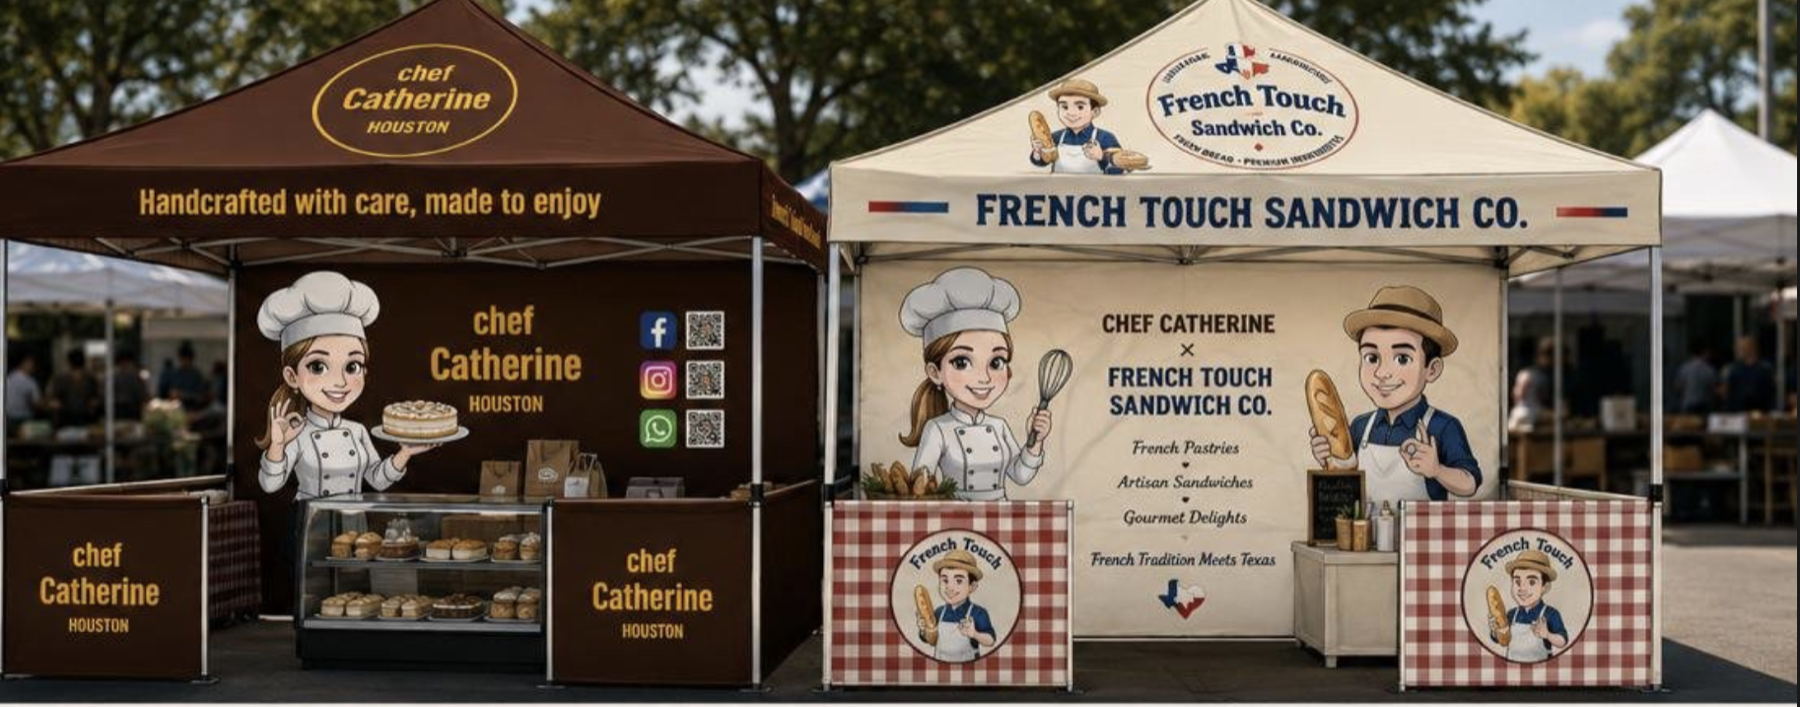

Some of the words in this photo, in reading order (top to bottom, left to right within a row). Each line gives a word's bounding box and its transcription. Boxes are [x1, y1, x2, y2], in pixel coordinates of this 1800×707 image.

[397, 63, 455, 82] chef
[343, 87, 490, 110] Catherine
[1157, 84, 1254, 117] French
[1256, 84, 1346, 118] Touch
[367, 120, 449, 134] HOUSTON
[1191, 119, 1286, 136] Sandwich
[1290, 119, 1323, 136] Co.
[139, 188, 287, 215] Handcrafted
[295, 188, 347, 215] with
[355, 192, 417, 218] care,
[425, 188, 493, 215] made
[501, 189, 526, 215] to
[534, 187, 601, 219] enjoy
[976, 194, 1127, 228] FRENCH
[1139, 196, 1253, 229] TOUCH
[1265, 196, 1460, 229] SANDWICH
[1472, 196, 1528, 229] CO.
[473, 304, 534, 336] chef
[1102, 313, 1154, 334] CHEF
[1159, 313, 1276, 334] CATHERINE
[430, 346, 582, 381] Catherine
[1108, 367, 1193, 388] FRENCH
[1199, 367, 1272, 388] TOUCH
[469, 395, 543, 412] HOUSTON
[1110, 394, 1231, 416] SANDWICH
[1238, 394, 1272, 416] CO.
[1132, 439, 1180, 455] French
[1183, 439, 1240, 455] Pastries
[1117, 474, 1169, 489] Artisan
[1172, 474, 1253, 489] Sandwiches
[1123, 509, 1185, 526] Gourmet
[1188, 509, 1248, 528] Delights
[72, 541, 123, 567] chef
[627, 548, 677, 573] chef
[909, 537, 957, 570] French
[963, 537, 1002, 570] Touch
[1091, 551, 1135, 567] French
[1138, 551, 1196, 567] Tradition
[1198, 551, 1237, 566] Meets
[1240, 552, 1276, 567] Texas
[1481, 536, 1529, 570] French
[1536, 537, 1574, 569] Touch
[40, 576, 160, 606] Catherine
[592, 582, 713, 612] Catherine
[68, 616, 130, 633] HOUSTON
[623, 622, 684, 639] HOUSTON
